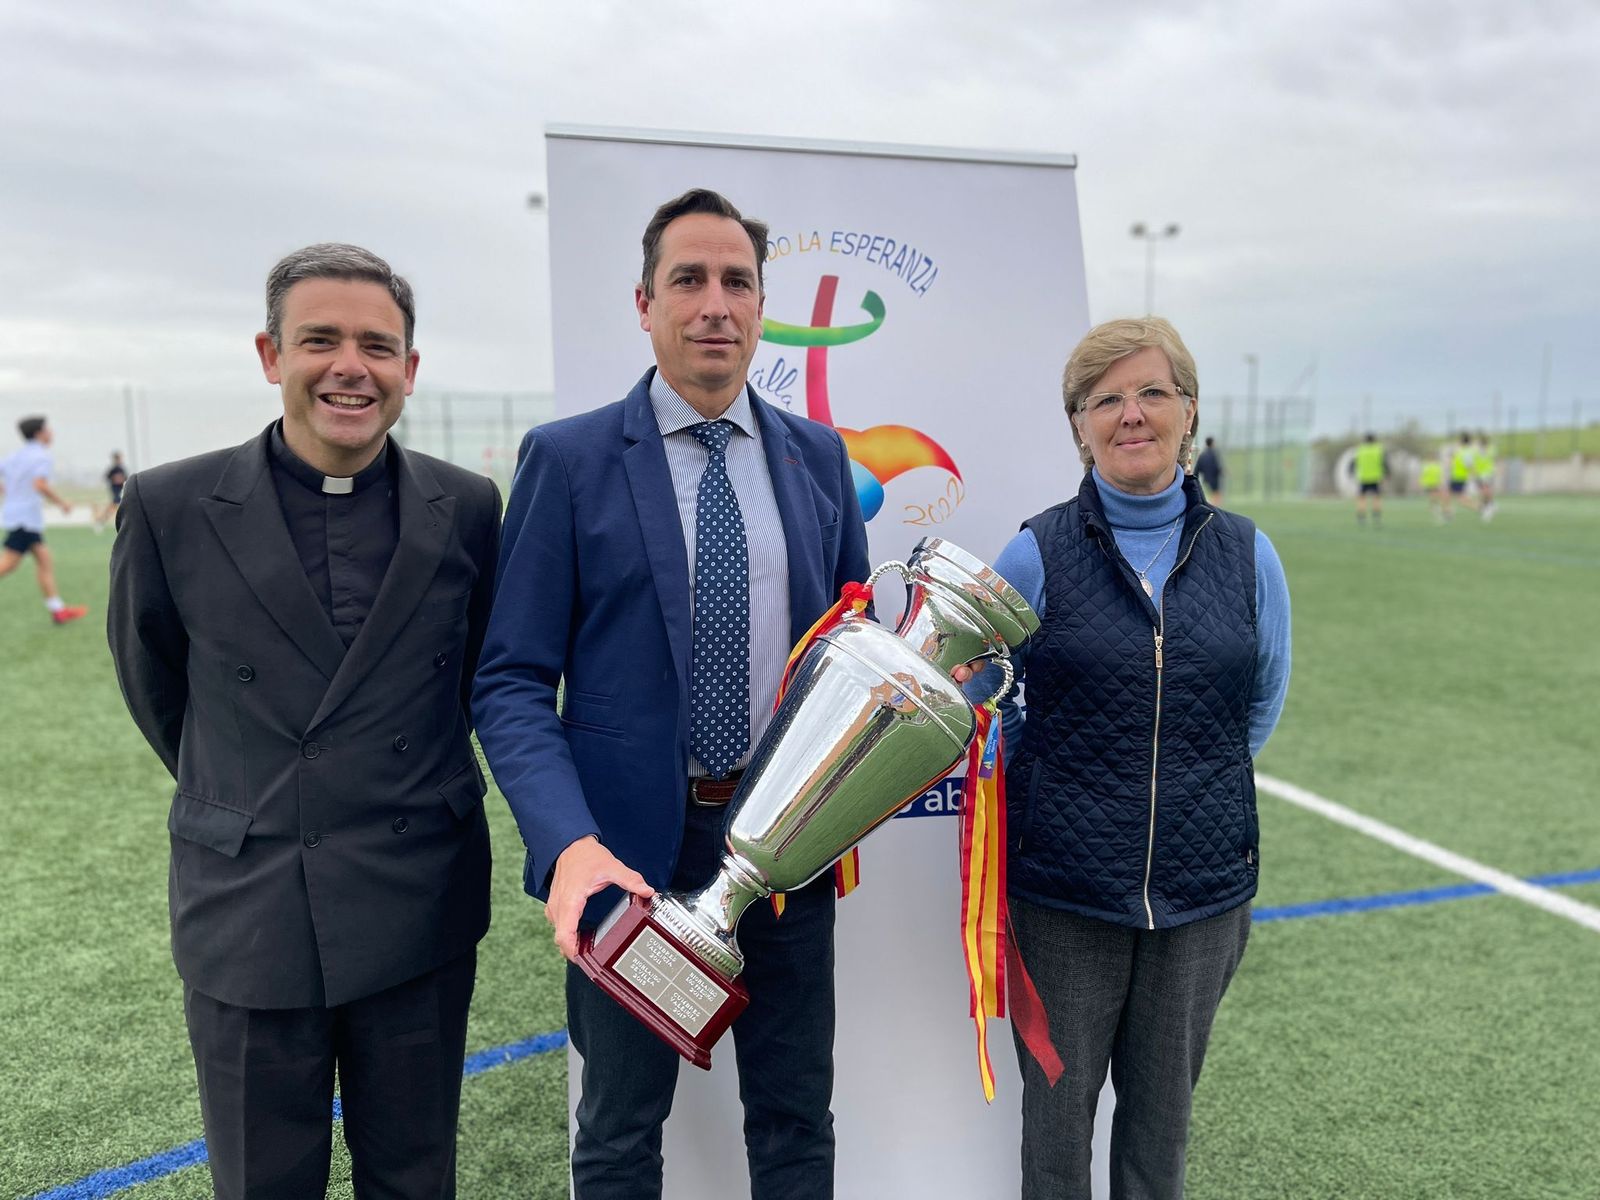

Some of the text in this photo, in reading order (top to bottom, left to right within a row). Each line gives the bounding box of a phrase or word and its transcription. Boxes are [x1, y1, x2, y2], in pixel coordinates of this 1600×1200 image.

[798, 231, 821, 253] LA
[830, 231, 939, 298] ESPERANZA
[903, 476, 965, 529] 2022
[646, 942, 672, 967] VALENCIA
[649, 937, 677, 962] CUMBRES
[630, 964, 655, 986] SEVILLA
[670, 997, 696, 1022] VALENCIA
[673, 992, 701, 1017] CUMBRES
